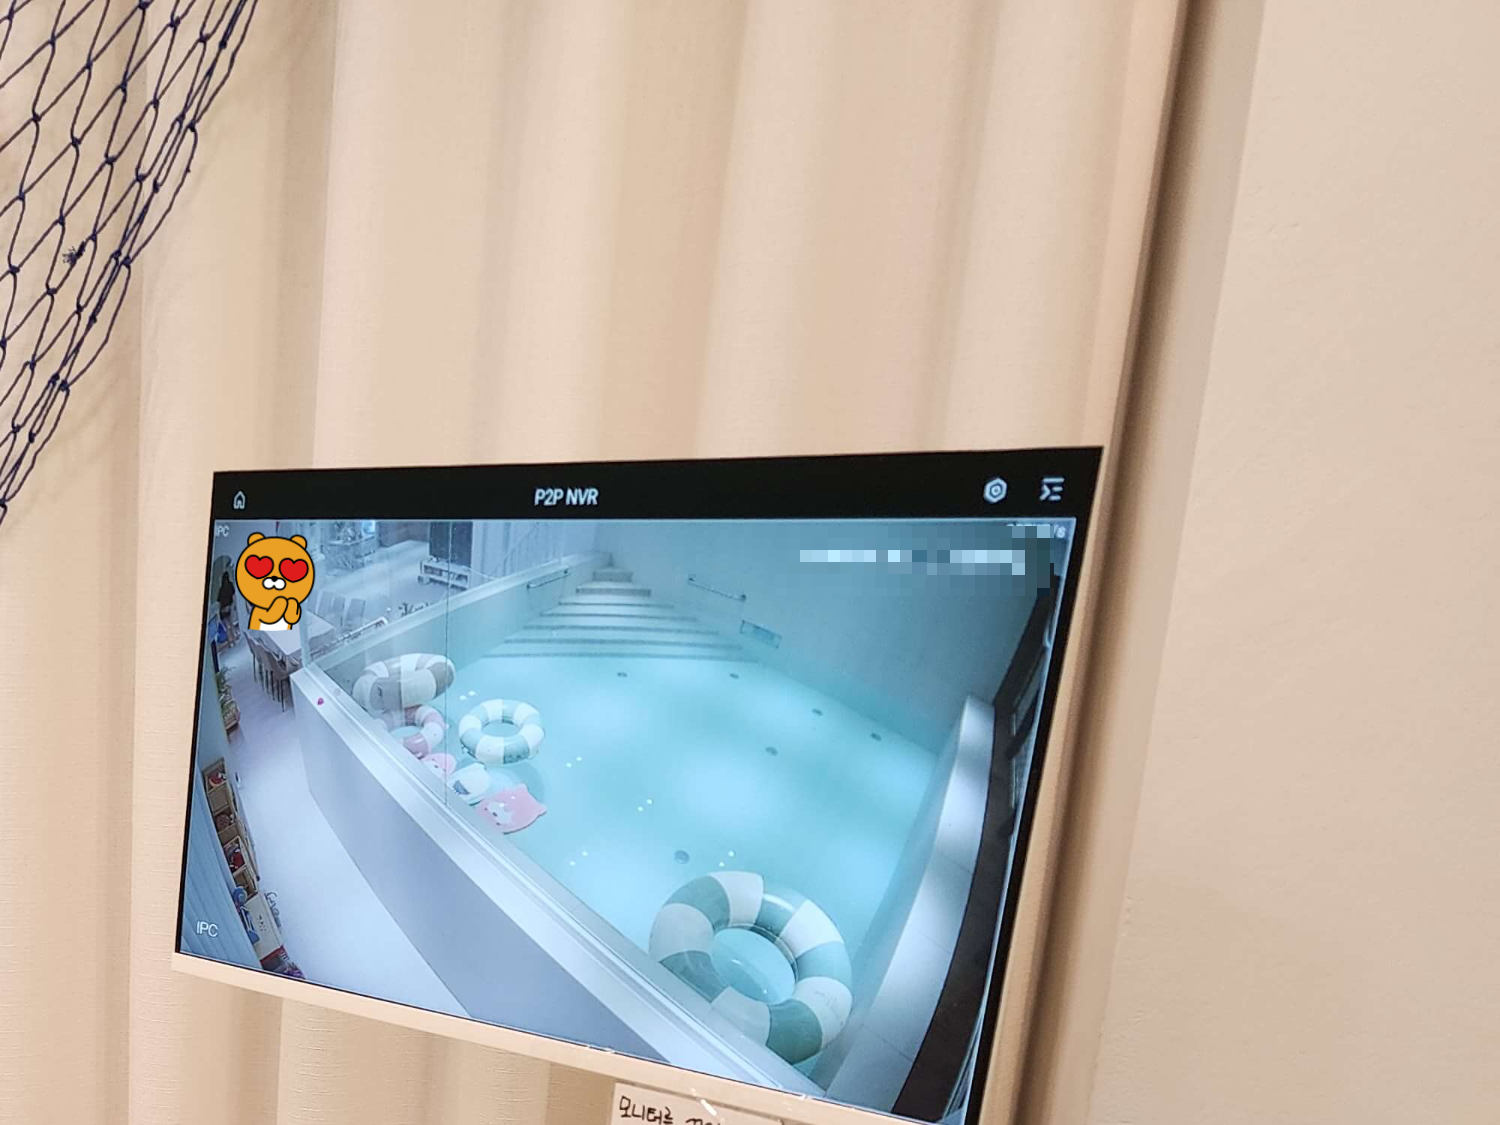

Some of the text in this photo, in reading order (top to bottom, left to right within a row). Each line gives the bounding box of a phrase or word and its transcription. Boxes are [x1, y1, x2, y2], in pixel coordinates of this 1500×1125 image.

[534, 488, 599, 506] P2P NVR
[196, 920, 218, 937] IPC
